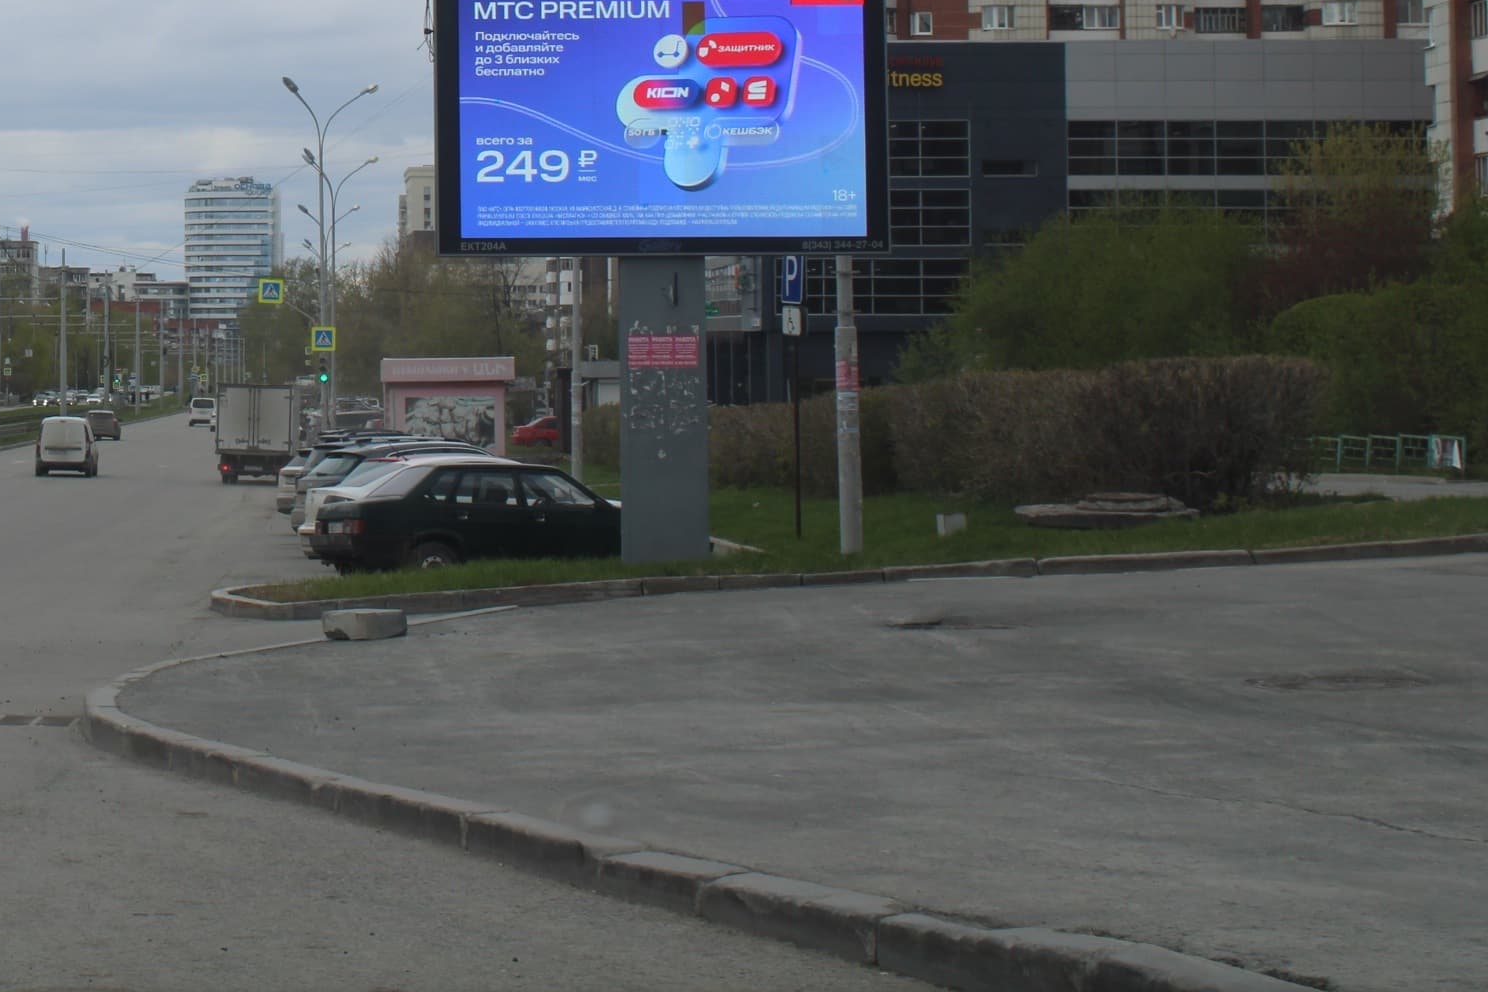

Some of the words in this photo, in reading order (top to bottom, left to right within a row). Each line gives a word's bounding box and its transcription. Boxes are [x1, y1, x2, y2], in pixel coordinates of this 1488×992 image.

[473, 1, 534, 20] МТС
[540, 0, 670, 19] PREMIUM
[475, 30, 580, 42] Подключайтесь
[475, 45, 483, 53] и
[485, 42, 564, 54] добавляйте
[717, 44, 776, 53] ЗАЩИТНИК
[475, 56, 492, 66] до
[494, 55, 503, 65] 3
[505, 54, 560, 65] близких
[475, 66, 545, 77] бесплатно
[646, 87, 689, 98] KION
[722, 126, 773, 136] КЕШБЭК
[475, 136, 515, 146] всего
[516, 136, 533, 146] за
[476, 149, 570, 183] 249
[577, 175, 598, 183] мес
[832, 189, 857, 202] 18+
